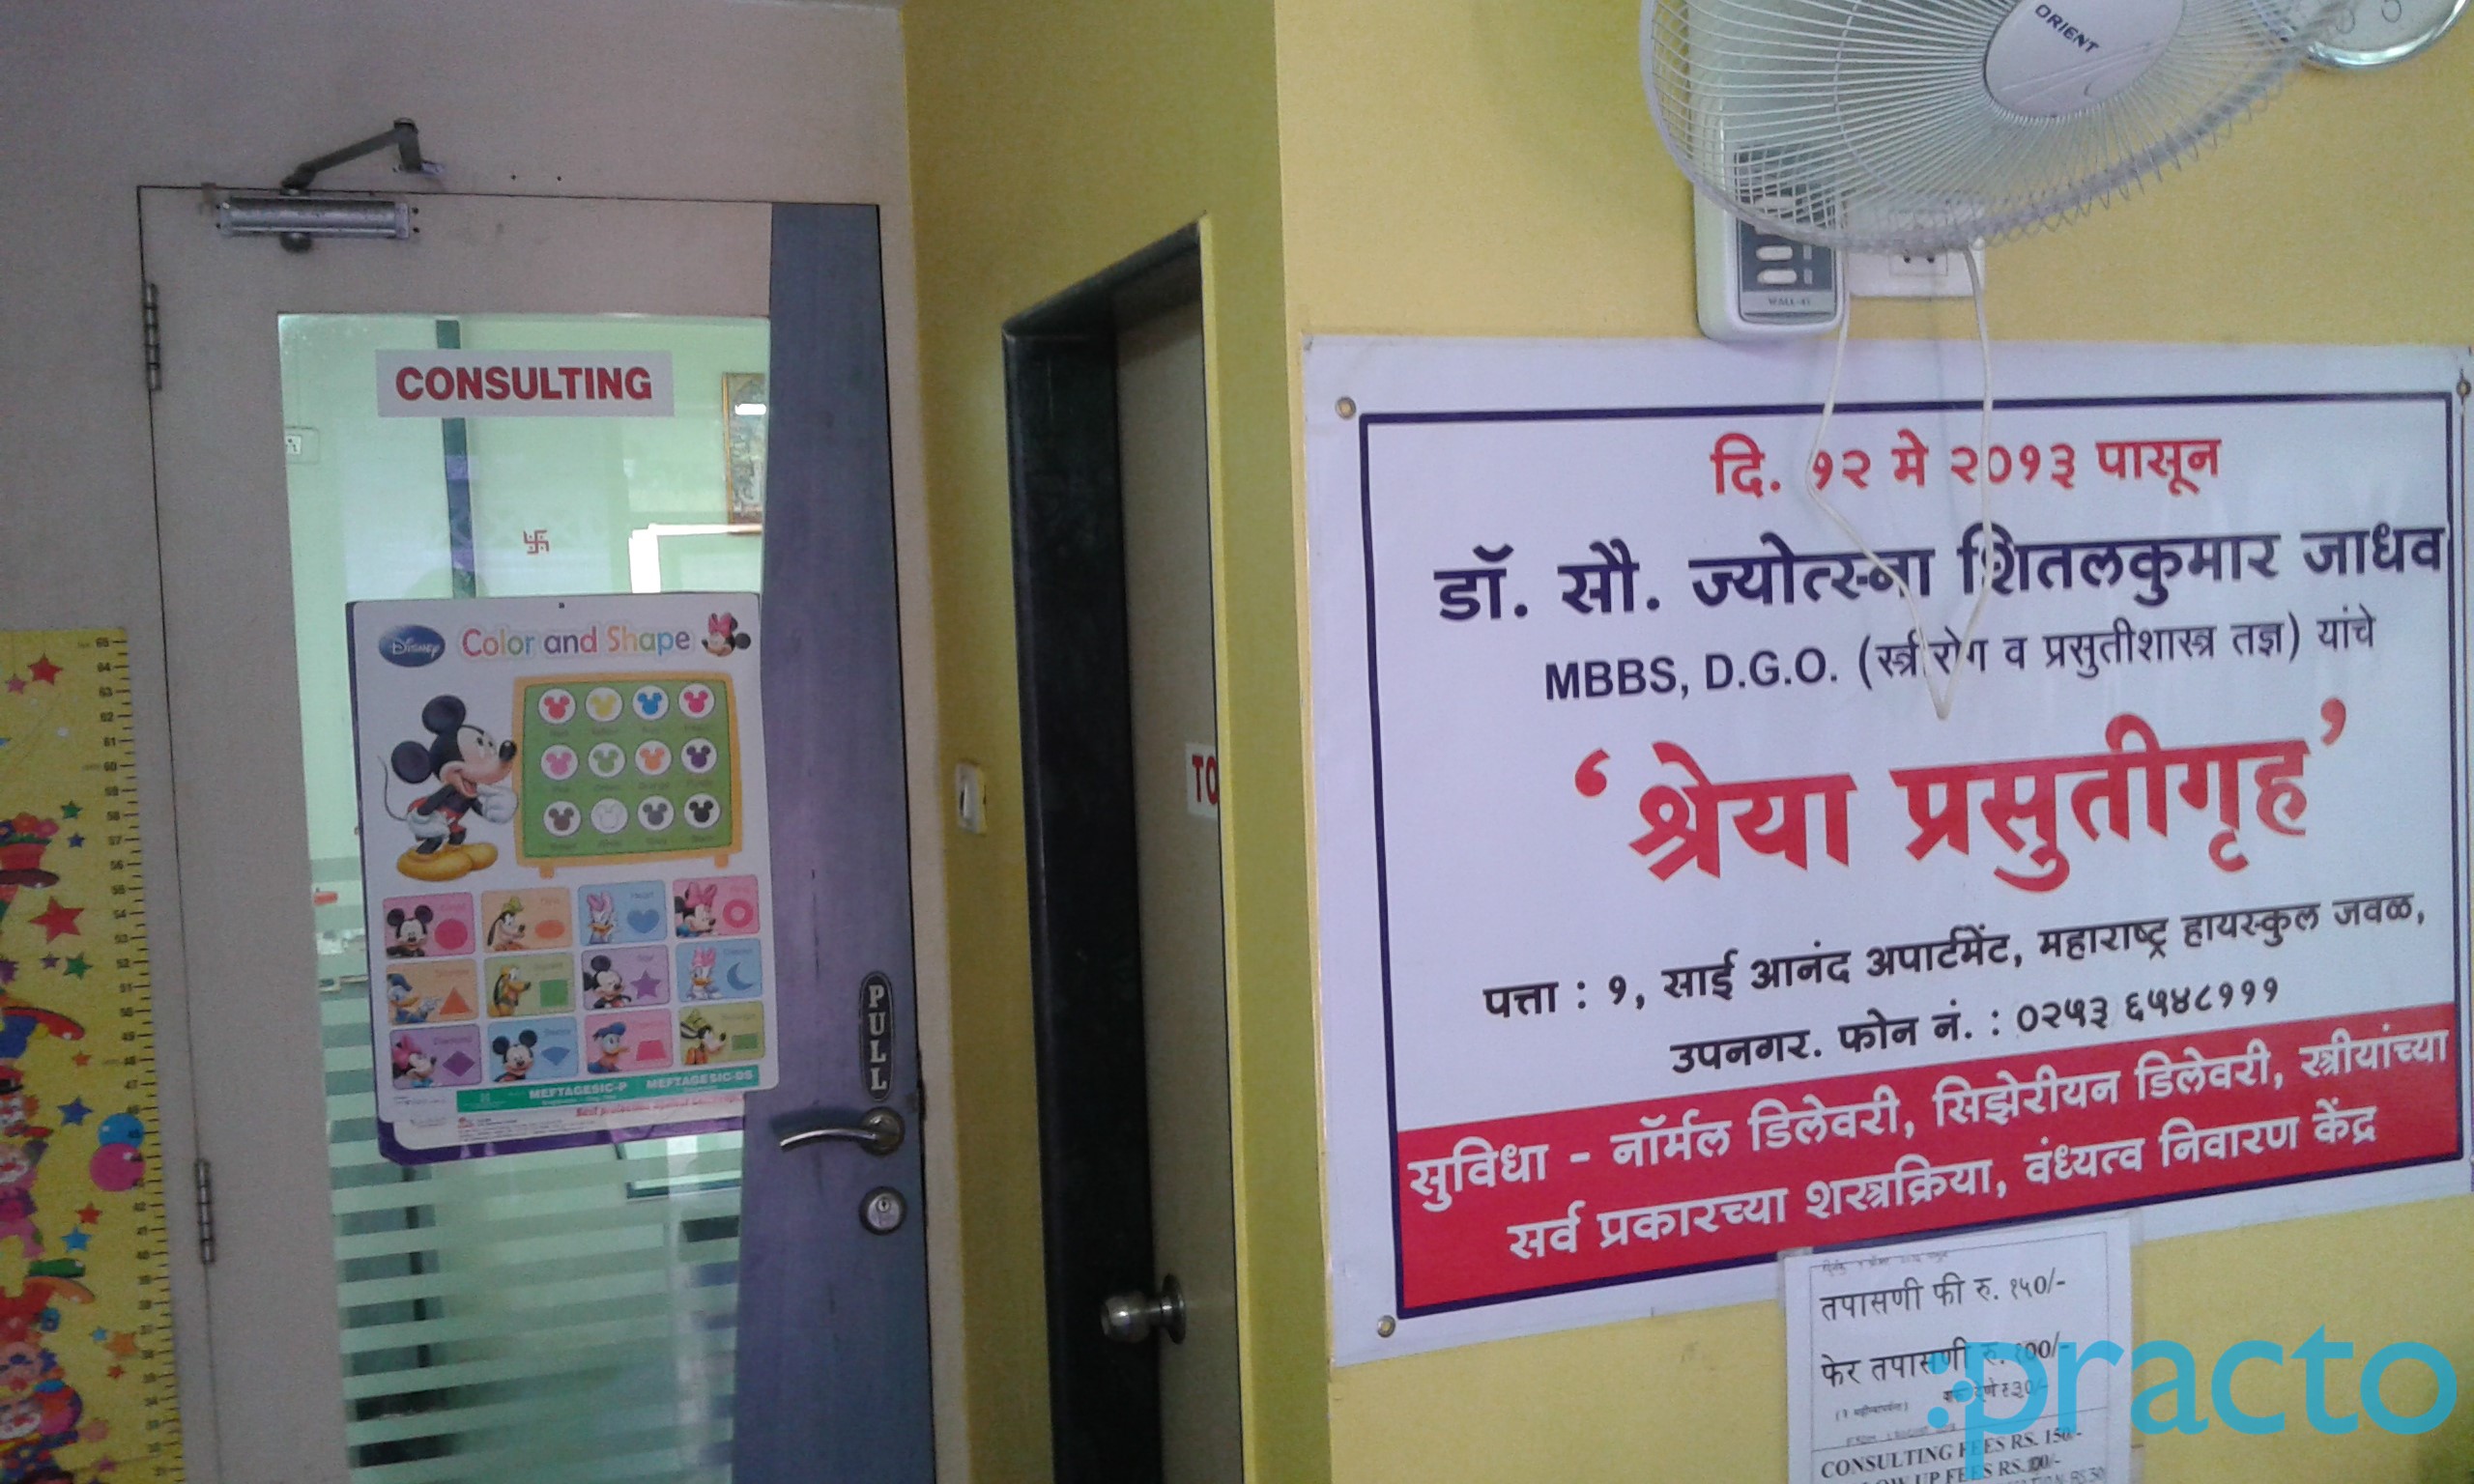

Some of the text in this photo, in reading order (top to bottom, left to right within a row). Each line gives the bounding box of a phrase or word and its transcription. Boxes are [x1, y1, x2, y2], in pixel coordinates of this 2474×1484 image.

[2035, 5, 2099, 52] ORIENT
[395, 366, 652, 401] CONSULTING
[1711, 428, 2222, 498] दि. १२ मे २०१३ पासून
[1433, 522, 2446, 621] डॉ. सौ. ज्योत्स्ना शितलकुमार जाधव
[391, 638, 442, 660] Disney
[462, 625, 691, 658] Color and Shape
[1545, 655, 1690, 702] MBBS,
[1706, 647, 1838, 690] D.G.O.
[2002, 636, 2028, 671] व
[2043, 616, 2218, 678] प्रसुतीशास्त्र
[2229, 610, 2300, 664] तज्ञ)
[2316, 602, 2376, 653] यांचे
[1483, 981, 1559, 1018] पत्ता
[1661, 948, 1739, 1002] साई
[1750, 939, 1852, 989] आनंद
[1866, 923, 2024, 978] अपार्टमेंट,
[2037, 918, 2169, 960] महाराष्ट्र
[2181, 901, 2320, 949] हायस्कुल
[2332, 892, 2426, 928] जवळ,
[869, 985, 887, 1091] PULL
[1670, 1029, 1823, 1074] उपनगर.
[1838, 1008, 1918, 1054] फोन
[1932, 998, 1972, 1042] नं.
[2017, 994, 2109, 1034] ०२५३
[2125, 976, 2280, 1022] ६५४८१११
[1407, 1136, 1549, 1213] सुविधा
[1610, 1108, 1733, 1168] नॉर्मल
[1748, 1084, 1914, 1153] डिलेवरी,
[1933, 1069, 2121, 1128] सिझेरीयन
[2134, 1038, 2284, 1101] डिलेवरी,
[2298, 1022, 2450, 1078] स्त्रीयांच्या
[1508, 1097, 2379, 1261] सर्व प्रकारच्या शस्त्रक्रिया, वंध्यत्व निवारण केंद्र
[1820, 1276, 1924, 1322] तपासणी
[1933, 1271, 1966, 1308] फी
[1974, 1276, 1999, 1301] रु.
[1821, 1353, 1861, 1388] फेर
[1871, 1335, 1972, 1382] तपासणी
[1822, 1443, 1952, 1478] CONSULTING
[1959, 1437, 2005, 1459] FEES
[2012, 1431, 2038, 1449] RS.
